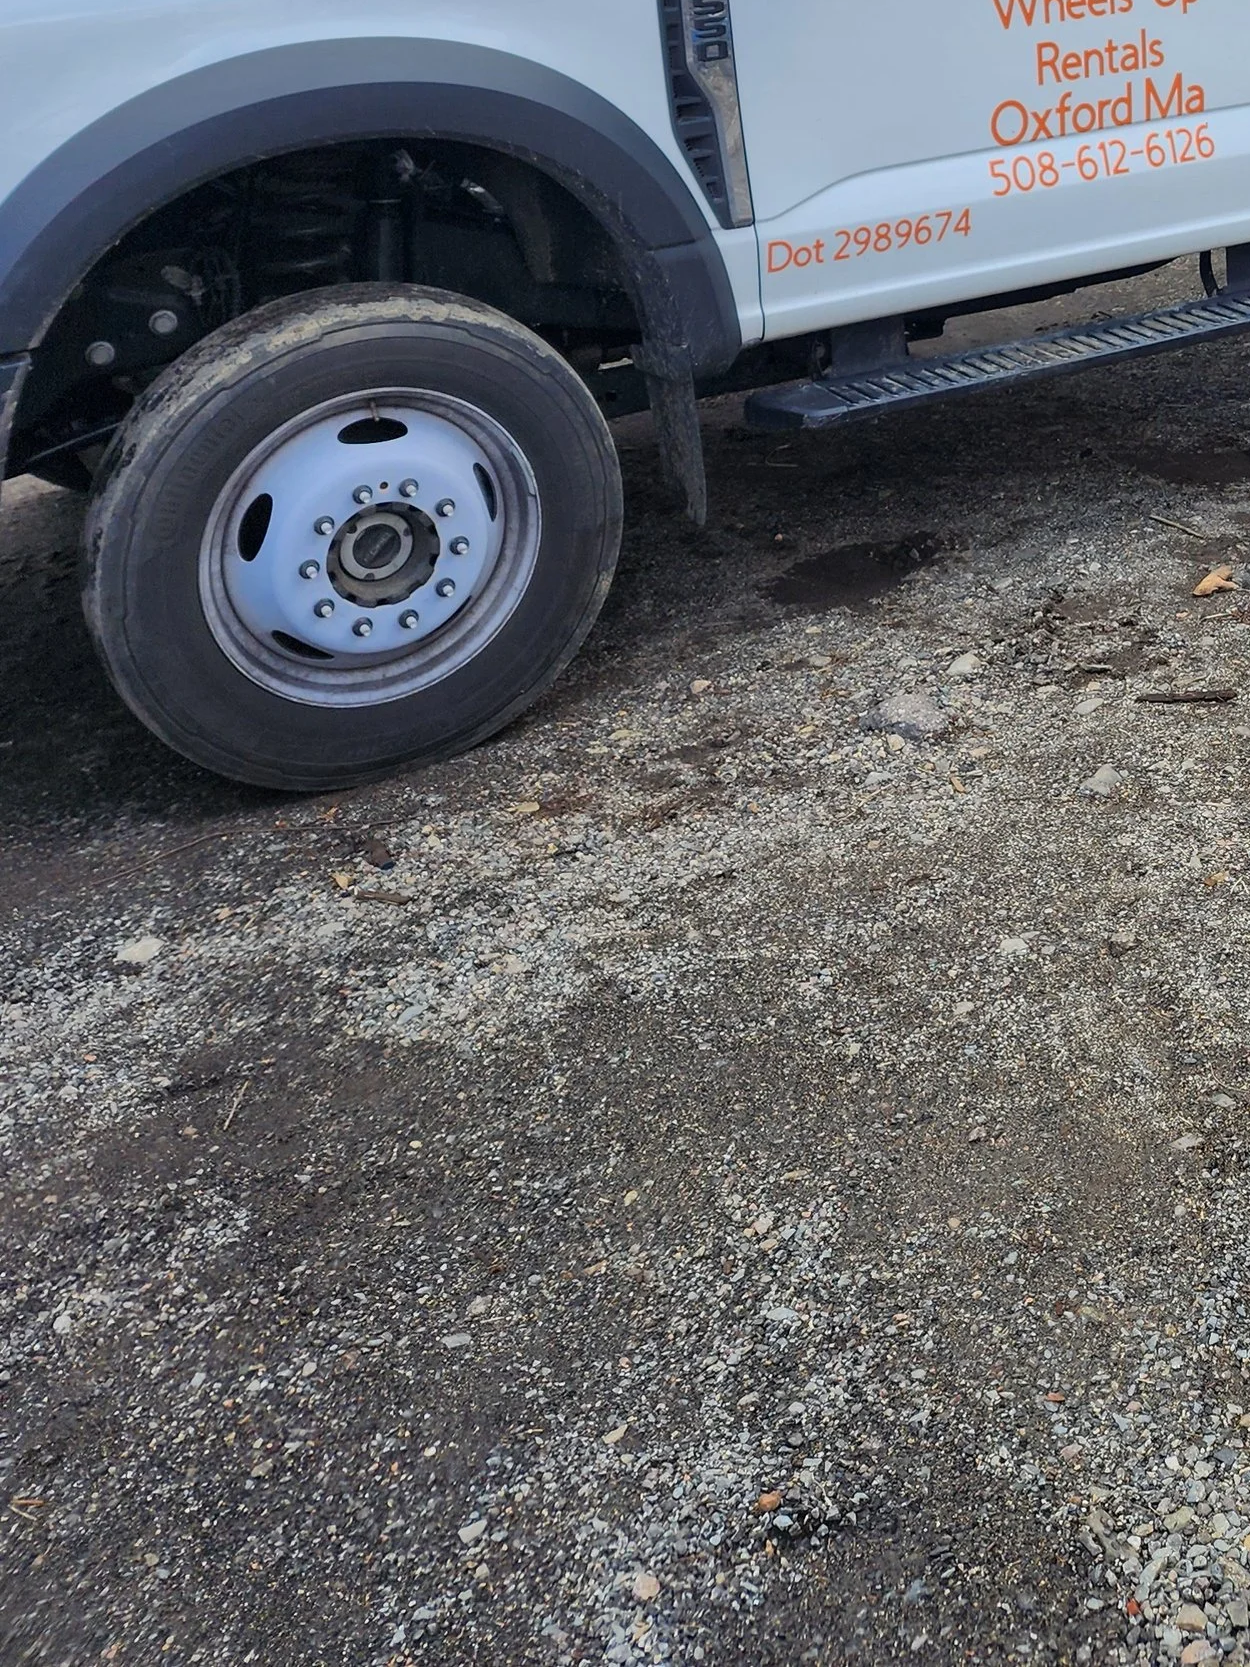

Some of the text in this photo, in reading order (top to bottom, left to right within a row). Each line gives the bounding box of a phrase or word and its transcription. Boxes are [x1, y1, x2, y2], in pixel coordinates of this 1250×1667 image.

[1036, 28, 1165, 86] Rentals
[991, 72, 1205, 147] Oxford Ma
[988, 122, 1215, 197] 508-612-6126
[767, 208, 971, 274] Dot 2989674
